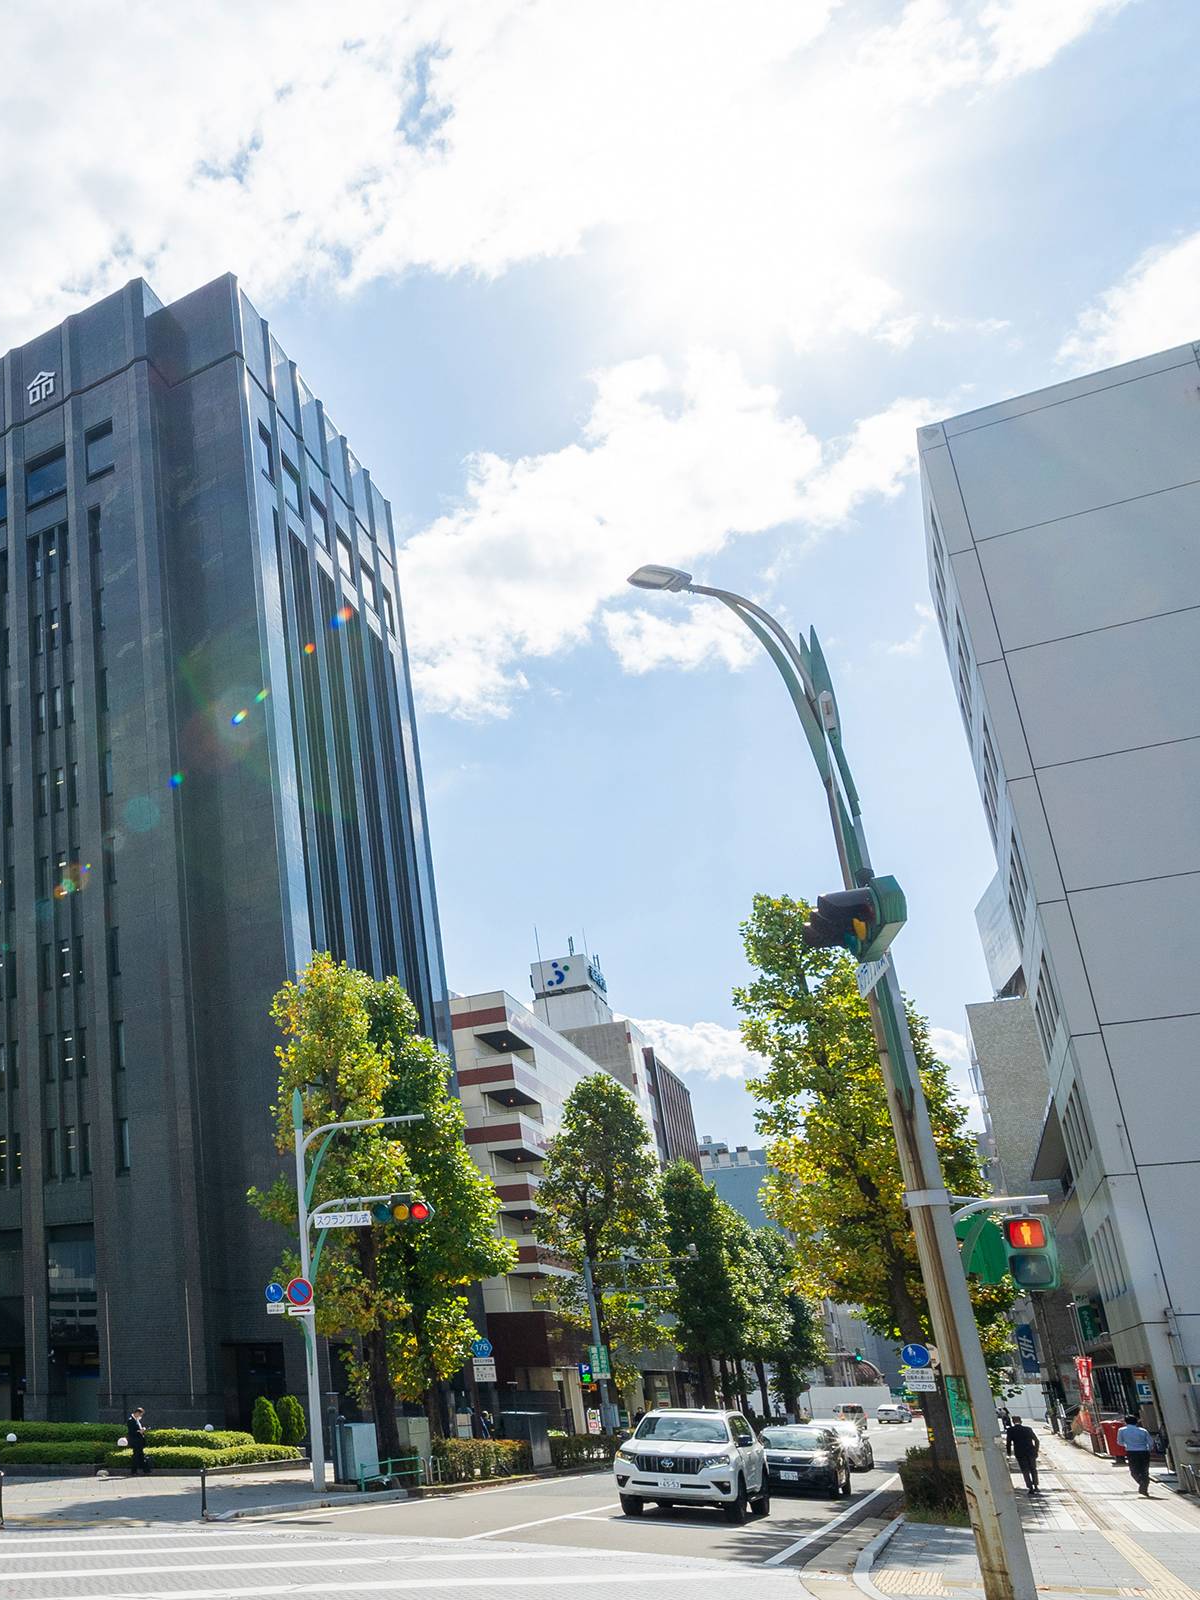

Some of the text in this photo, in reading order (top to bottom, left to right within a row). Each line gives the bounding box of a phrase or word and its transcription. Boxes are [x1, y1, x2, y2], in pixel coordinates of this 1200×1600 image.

[316, 1213, 370, 1226] スクランブル式
[475, 1343, 489, 1351] 176
[582, 1363, 590, 1373] P
